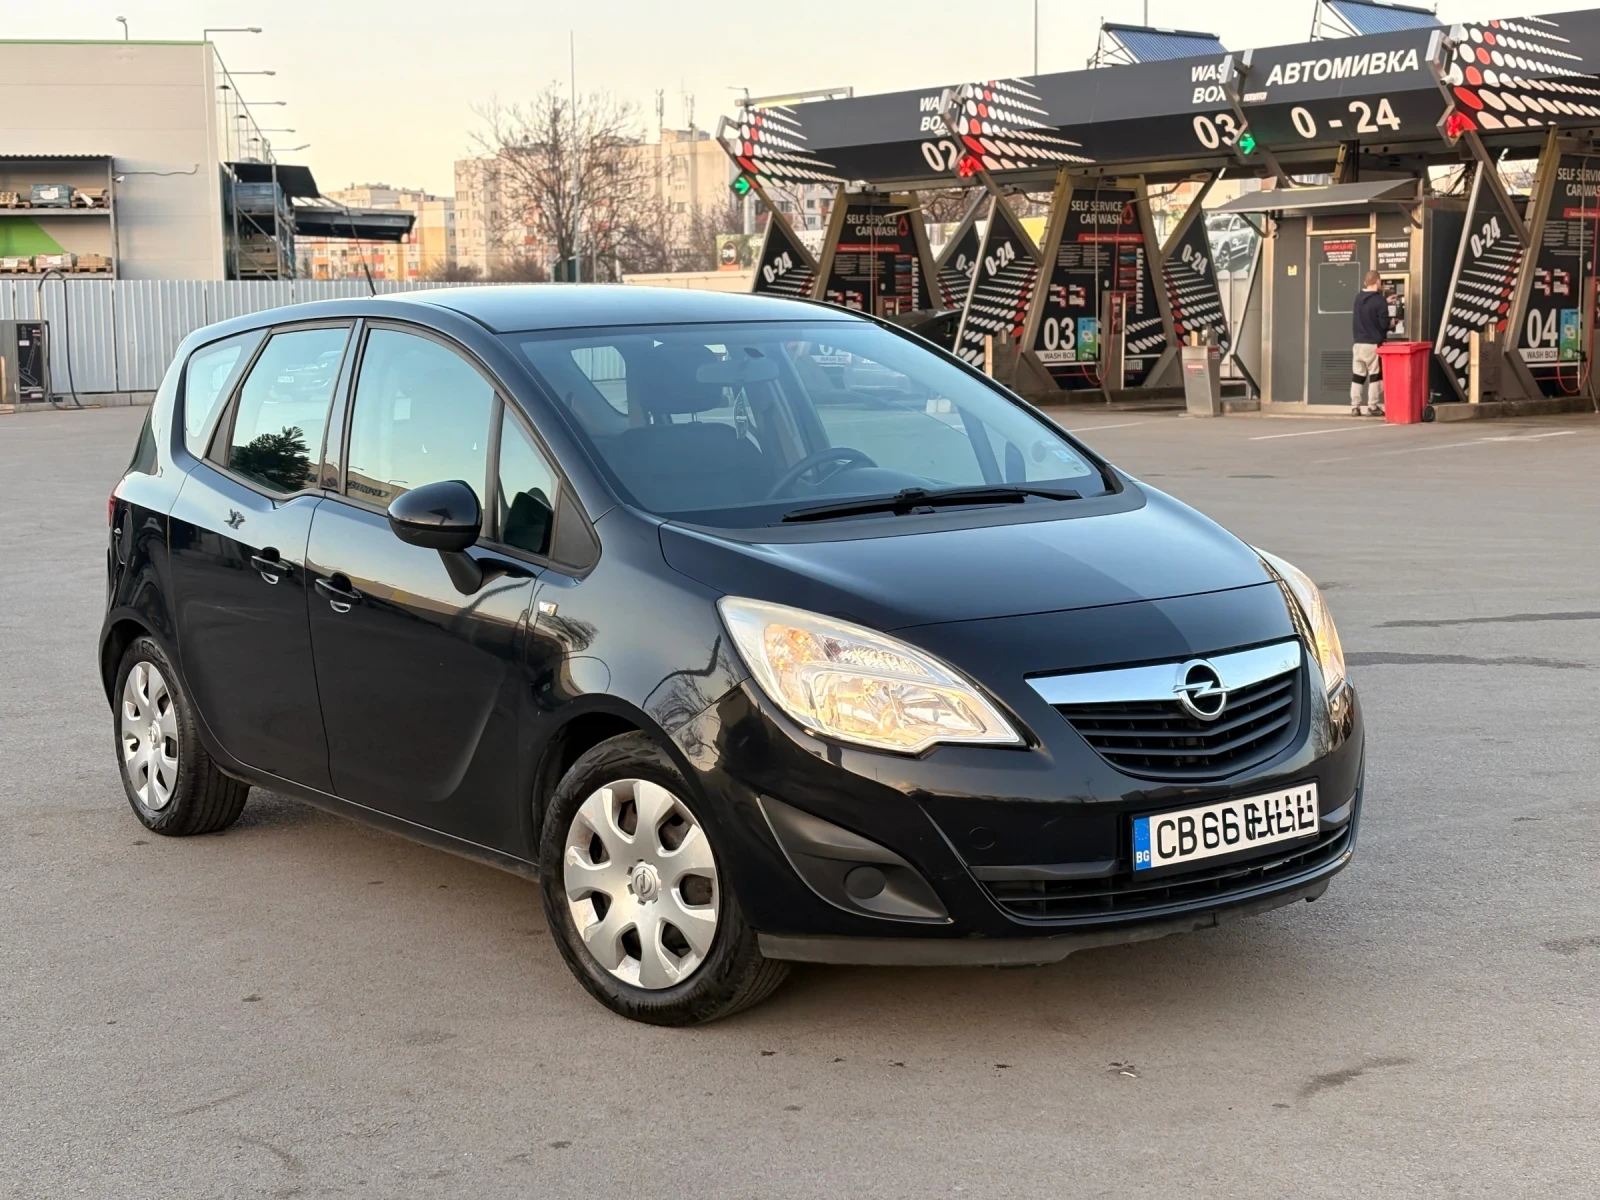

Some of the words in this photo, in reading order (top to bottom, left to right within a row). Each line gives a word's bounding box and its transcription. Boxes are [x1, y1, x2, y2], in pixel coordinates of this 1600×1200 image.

[1265, 49, 1419, 86] АВТОМИВКА
[1193, 113, 1239, 149] 03
[1291, 106, 1317, 138] 0
[1348, 98, 1401, 133] 24
[1558, 168, 1576, 180] SELF
[1566, 184, 1582, 196] CAR
[846, 214, 864, 224] SELF
[866, 214, 897, 225] SERVICE
[1071, 200, 1089, 211] SELF
[1090, 201, 1122, 212] SERVICE
[1080, 213, 1097, 224] CAR
[1098, 214, 1122, 225] WASH
[856, 226, 871, 236] CAR
[873, 226, 897, 236] WASH
[1470, 216, 1501, 258] 0-24
[763, 251, 793, 283] 0-24
[955, 253, 976, 279] 0-2
[985, 241, 1015, 276] 0-24
[1182, 244, 1208, 275] 0-24
[1043, 317, 1075, 350] 03
[1527, 308, 1558, 348] 04
[1527, 350, 1543, 359] WASH
[1544, 350, 1557, 358] BOX
[1135, 850, 1150, 864] BG
